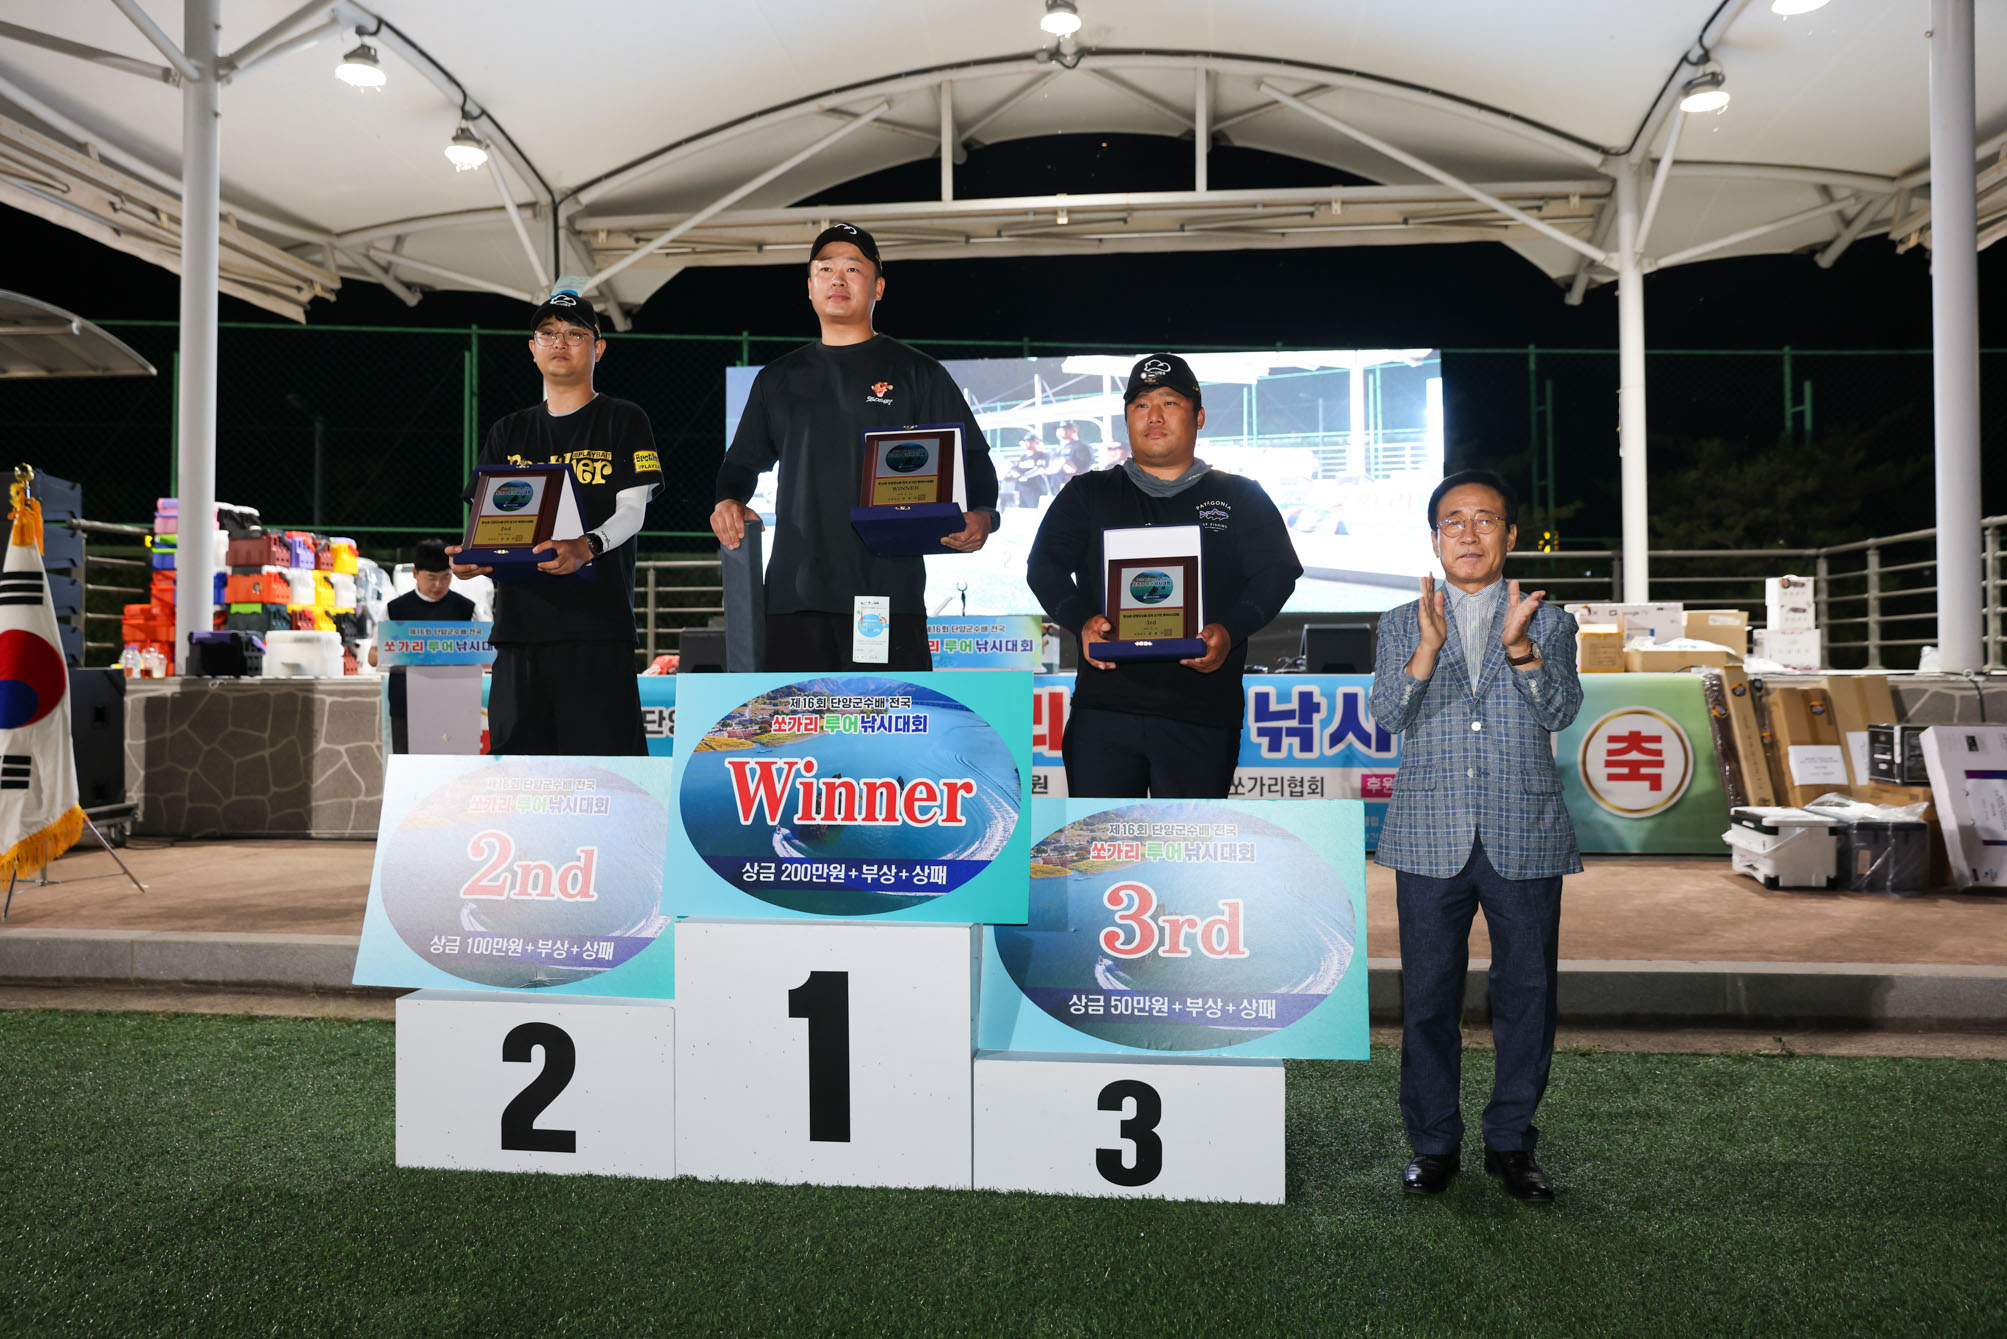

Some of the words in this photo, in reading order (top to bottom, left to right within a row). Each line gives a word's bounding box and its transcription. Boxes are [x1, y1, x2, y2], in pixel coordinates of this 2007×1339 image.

[1196, 501, 1231, 510] PATAGONIA
[384, 641, 424, 652] 쏘가리
[428, 641, 495, 652] 루어낚시대
[790, 697, 826, 709] 제16회
[830, 697, 885, 709] 단양군수배
[889, 697, 911, 709] 전국
[772, 715, 818, 733] 쏘가리
[1254, 690, 1392, 753] 낚시
[1604, 730, 1664, 791] 축
[575, 779, 596, 791] 전국
[727, 758, 976, 825] Winner
[470, 796, 512, 812] 쏘가리
[1108, 824, 1148, 836] 제16회
[1152, 824, 1210, 837] 단양군수배
[1214, 824, 1237, 837] 전국
[1091, 842, 1140, 861] 쏘가리
[461, 831, 598, 900] 2nd
[742, 862, 776, 882] 상금
[1101, 882, 1249, 958] 3rd
[430, 935, 461, 954] 상금
[1069, 995, 1105, 1015] 상금
[788, 970, 850, 1143] 1
[501, 1022, 576, 1153] 2
[1095, 1079, 1163, 1188] 3
